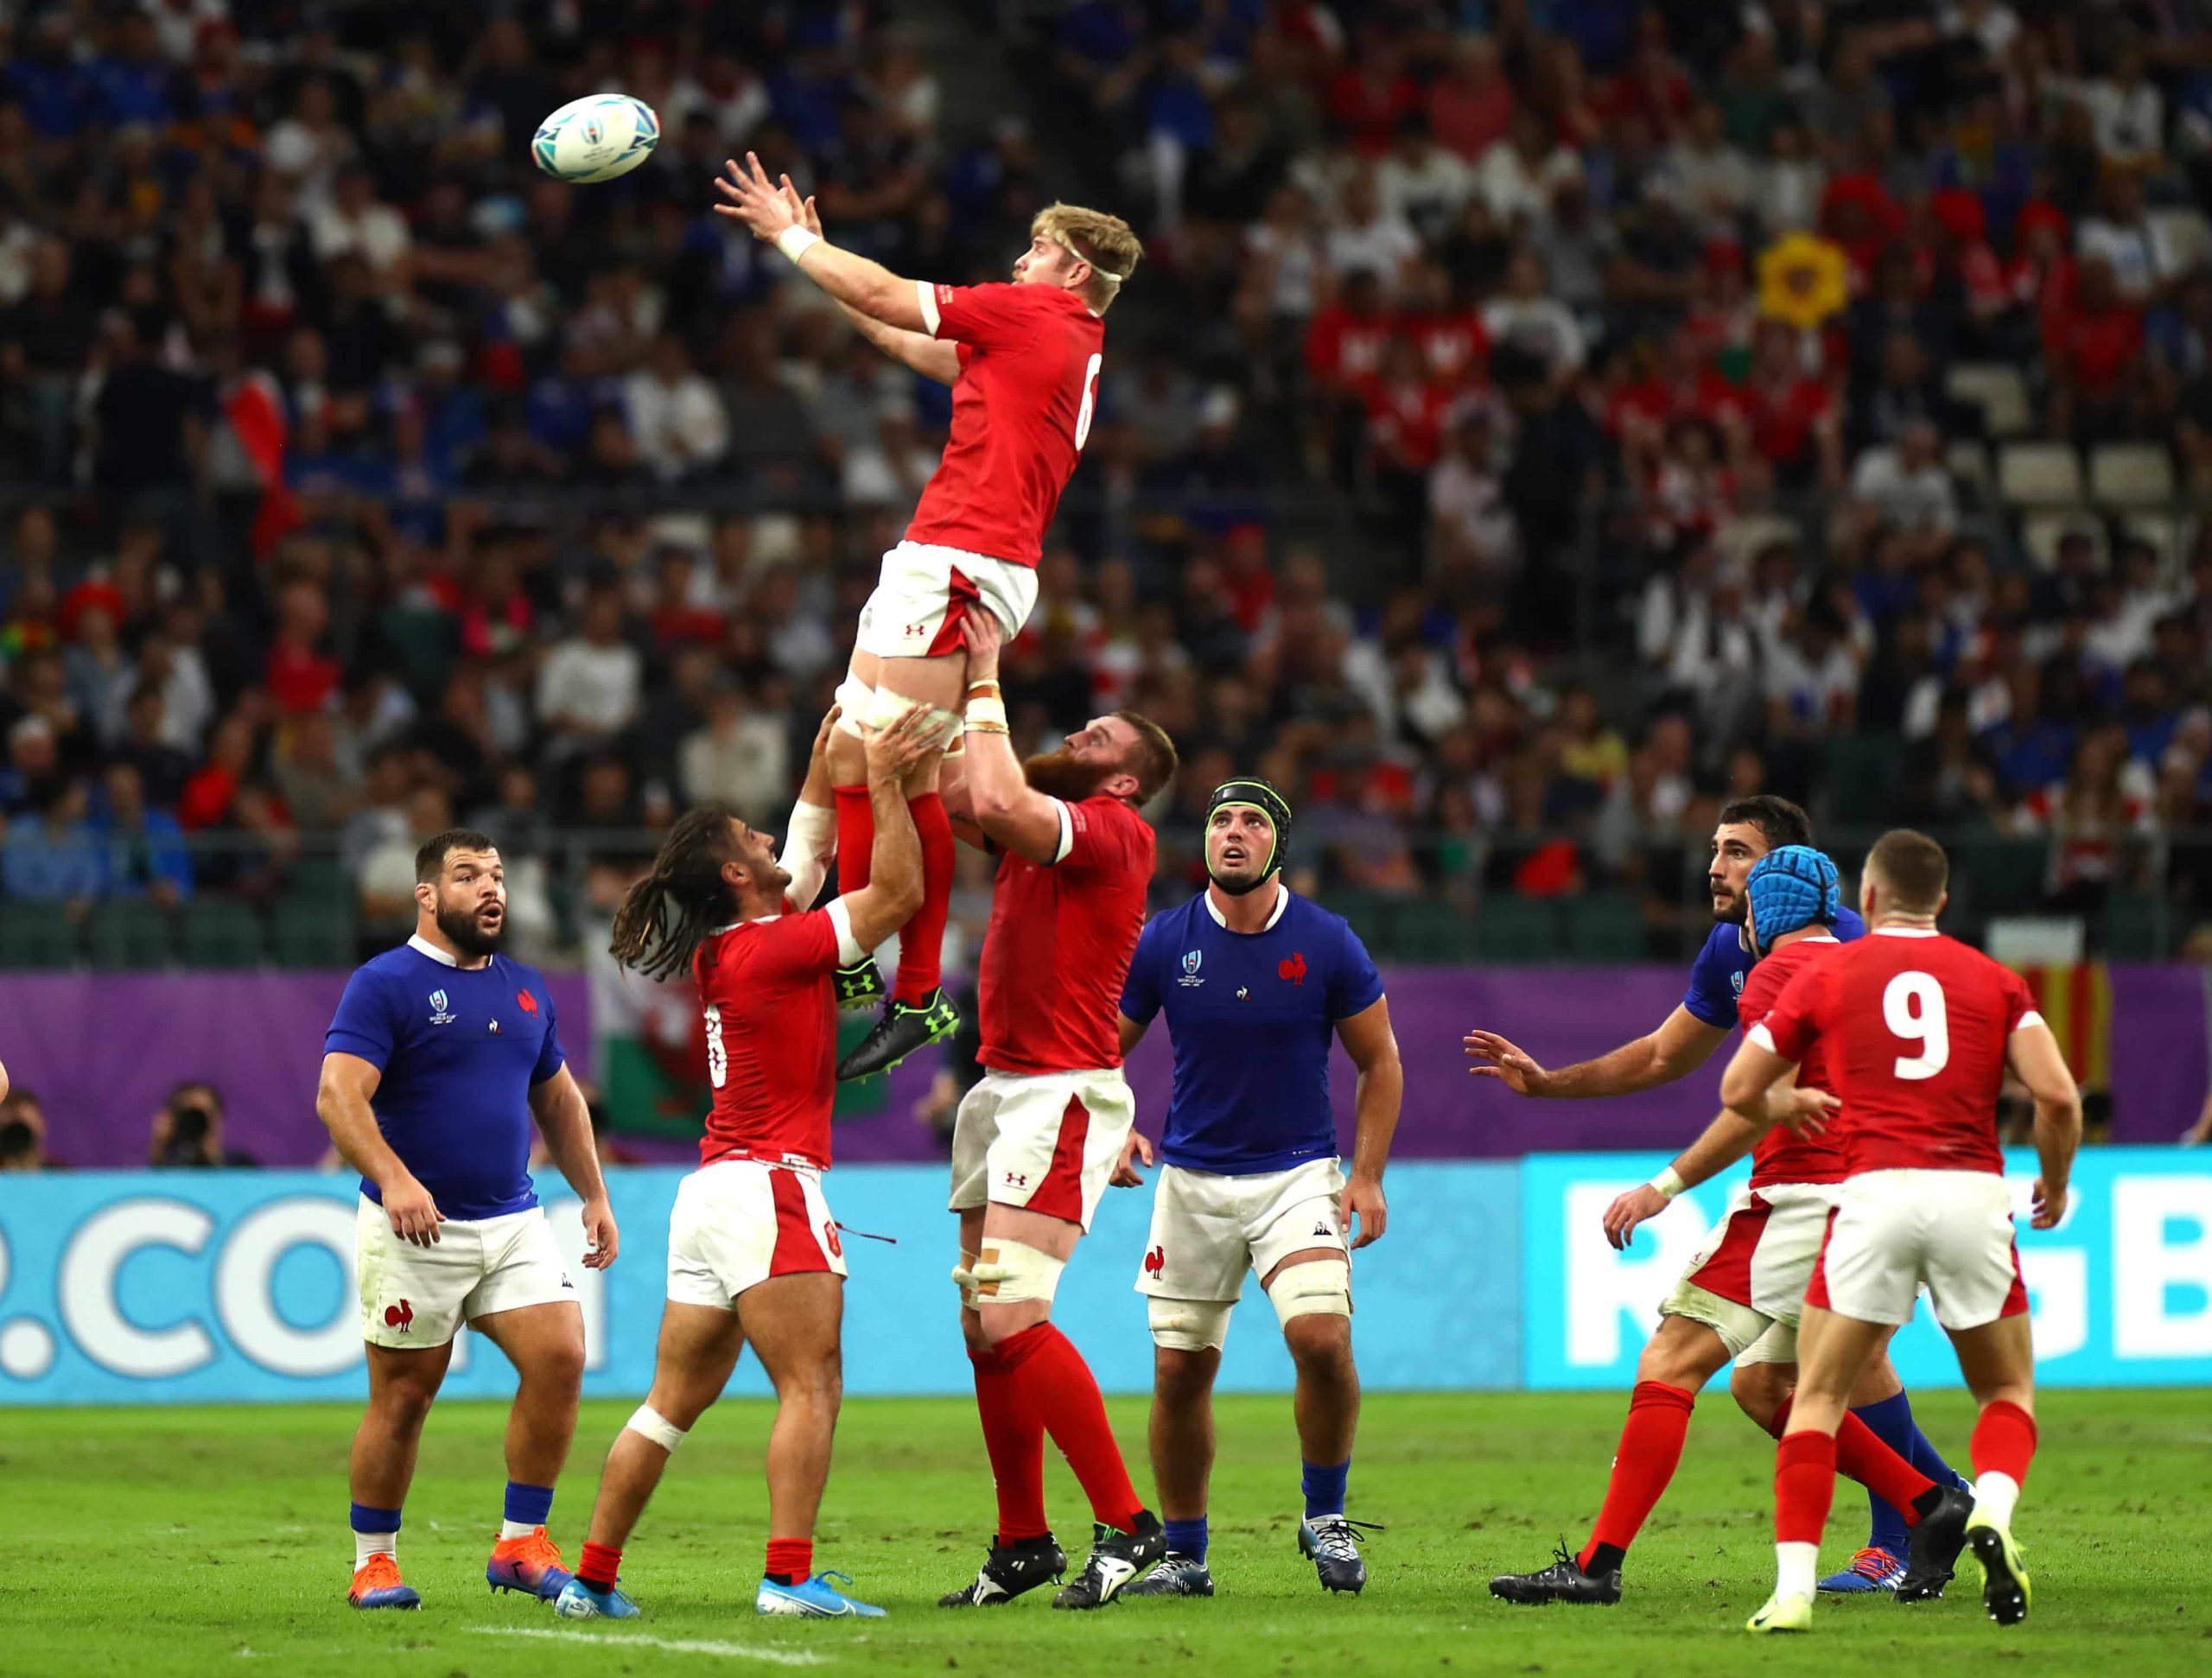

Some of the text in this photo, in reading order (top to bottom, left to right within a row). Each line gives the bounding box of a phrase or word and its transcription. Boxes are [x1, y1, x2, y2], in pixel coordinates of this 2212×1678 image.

[1883, 970, 1949, 1080] 9
[0, 1196, 604, 1376] .CO
[1565, 1175, 2212, 1365] RGB
